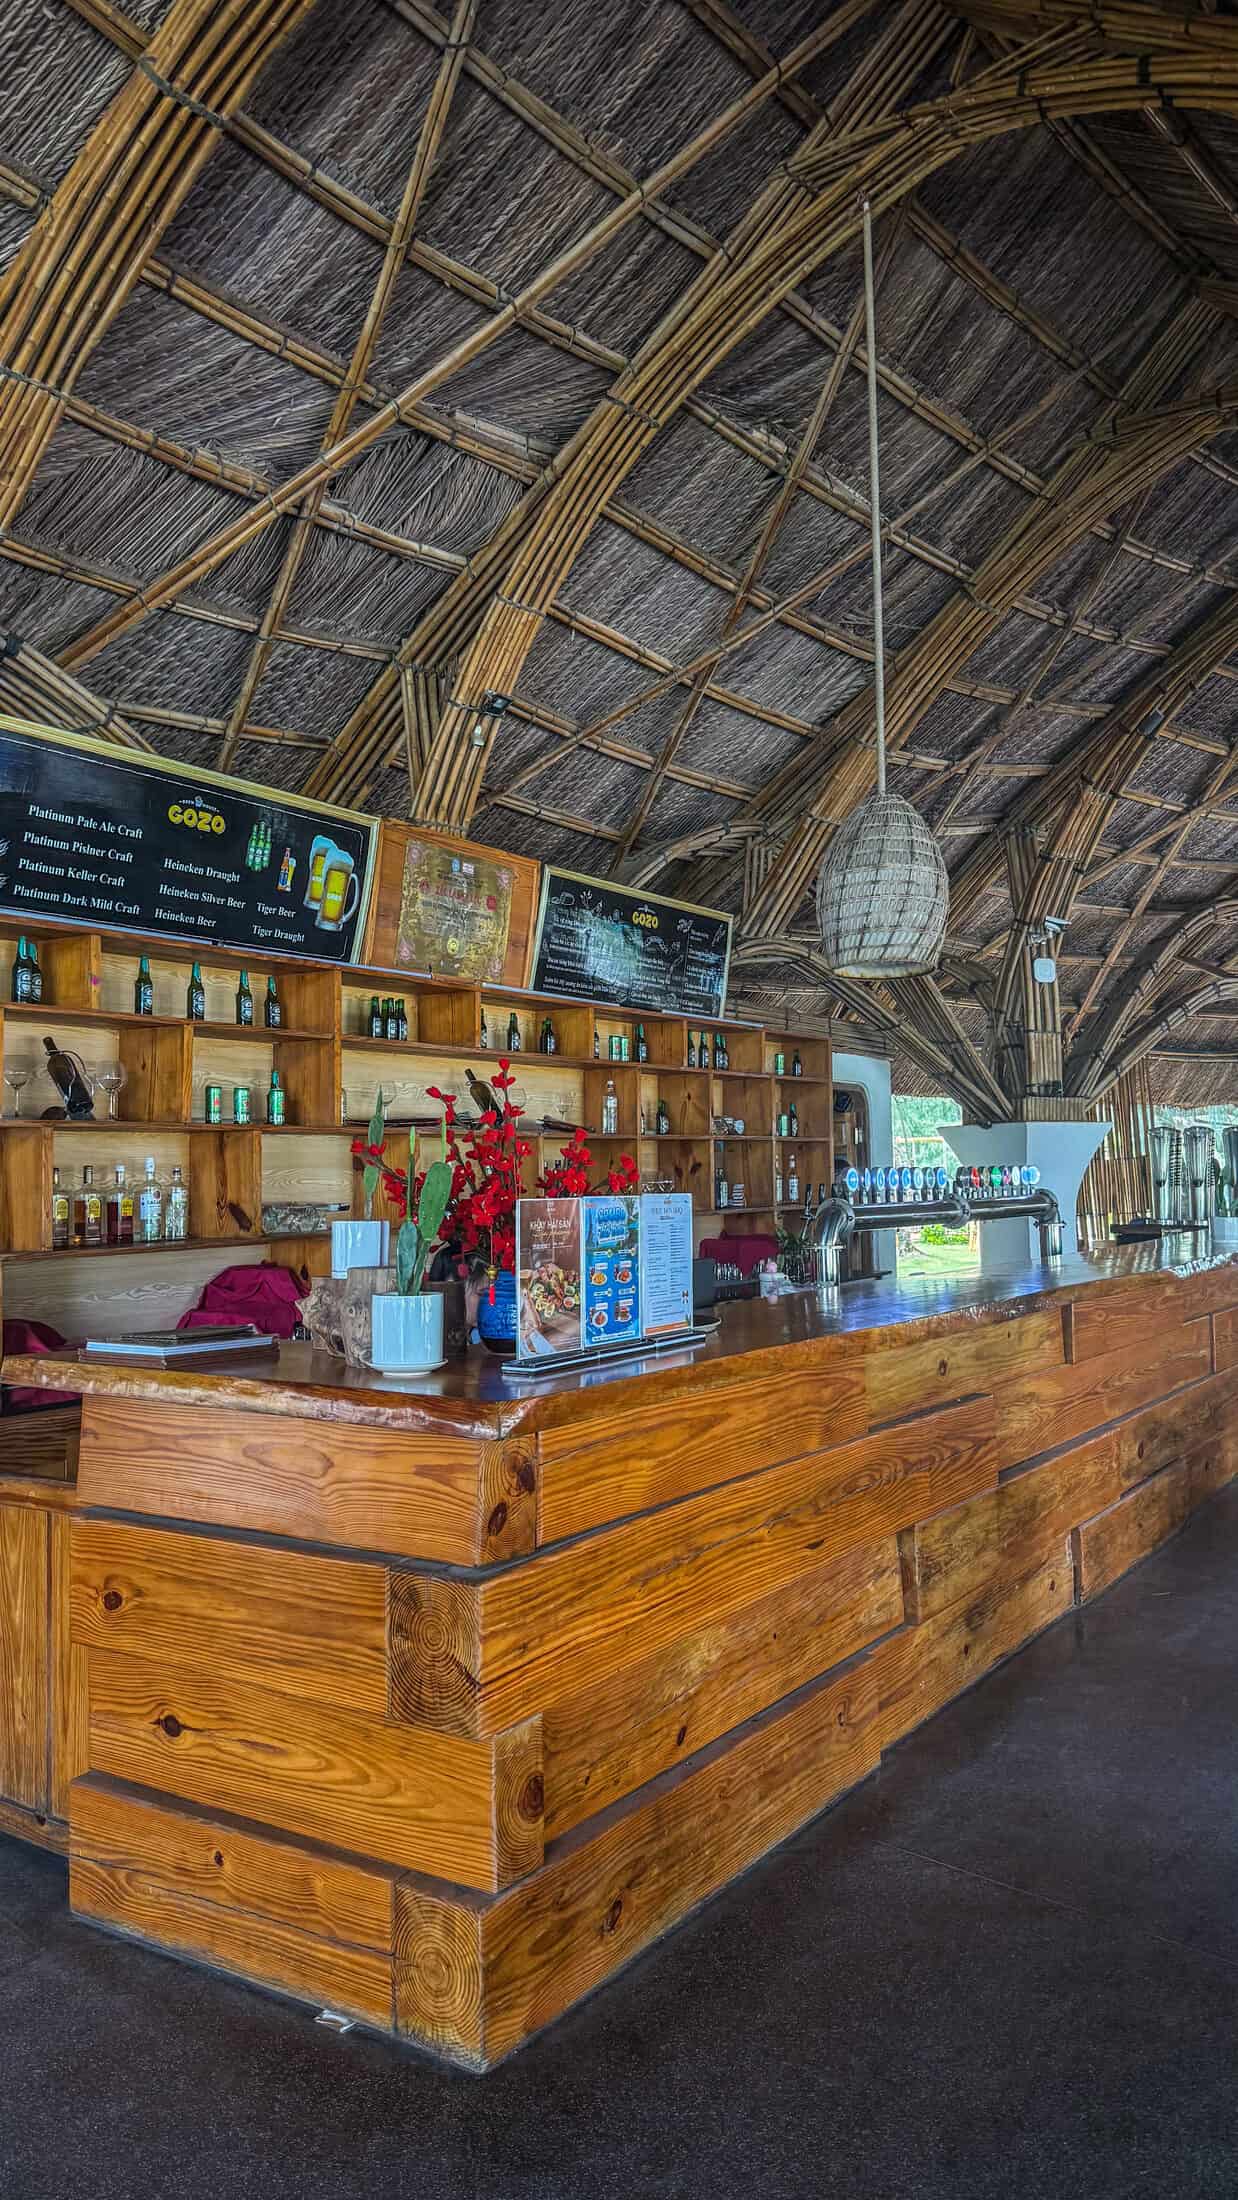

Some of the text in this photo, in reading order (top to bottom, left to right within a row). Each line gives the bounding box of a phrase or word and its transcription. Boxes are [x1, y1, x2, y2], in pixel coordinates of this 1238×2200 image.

[28, 804, 143, 839] Platinum Pale Ale Craft
[167, 804, 226, 834] GOZO
[23, 831, 69, 850] Platinum
[108, 848, 133, 863] Craft
[18, 858, 125, 887] Platinum Keller Craft
[164, 858, 240, 883] Heineken Draught
[13, 884, 140, 915] Platinum Dark Mild Craft
[159, 884, 246, 909] Heineken Silver Beer
[154, 908, 217, 928] Heineken Beer
[256, 902, 296, 918] Tiger Beer
[632, 911, 658, 929] GOZO
[252, 924, 304, 942] Tiger Draught
